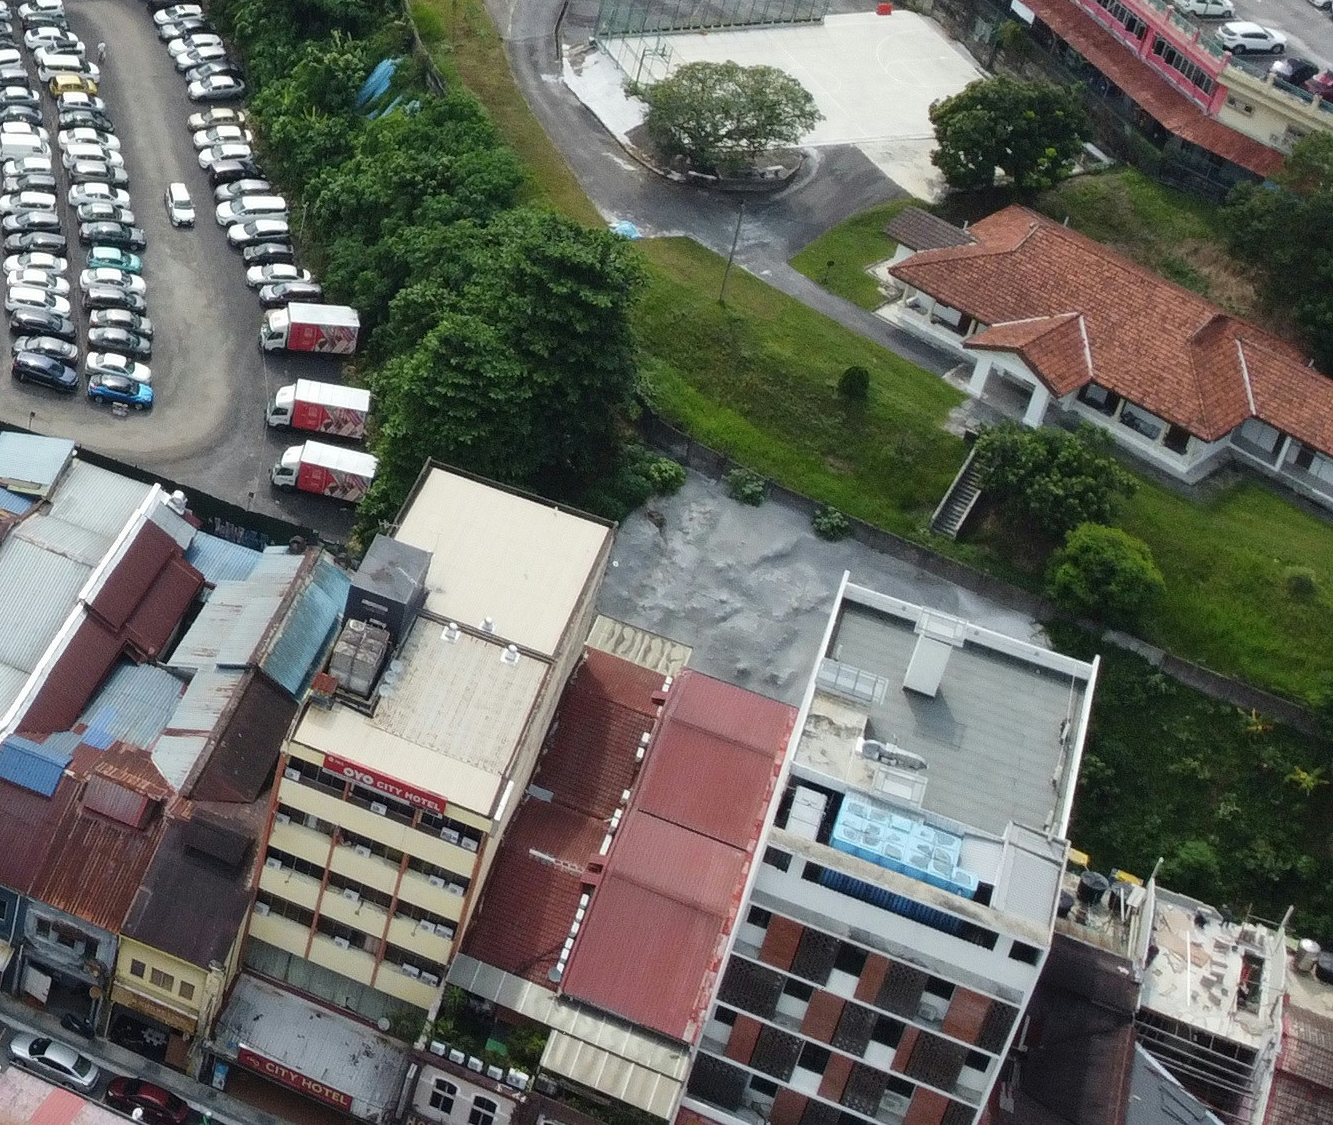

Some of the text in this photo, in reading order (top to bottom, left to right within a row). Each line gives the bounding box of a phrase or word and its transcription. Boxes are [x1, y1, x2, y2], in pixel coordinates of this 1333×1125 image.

[343, 766, 441, 812] OYO CITY HOTEL
[264, 1061, 299, 1089] CITY
[300, 1076, 349, 1107] HOTEL
